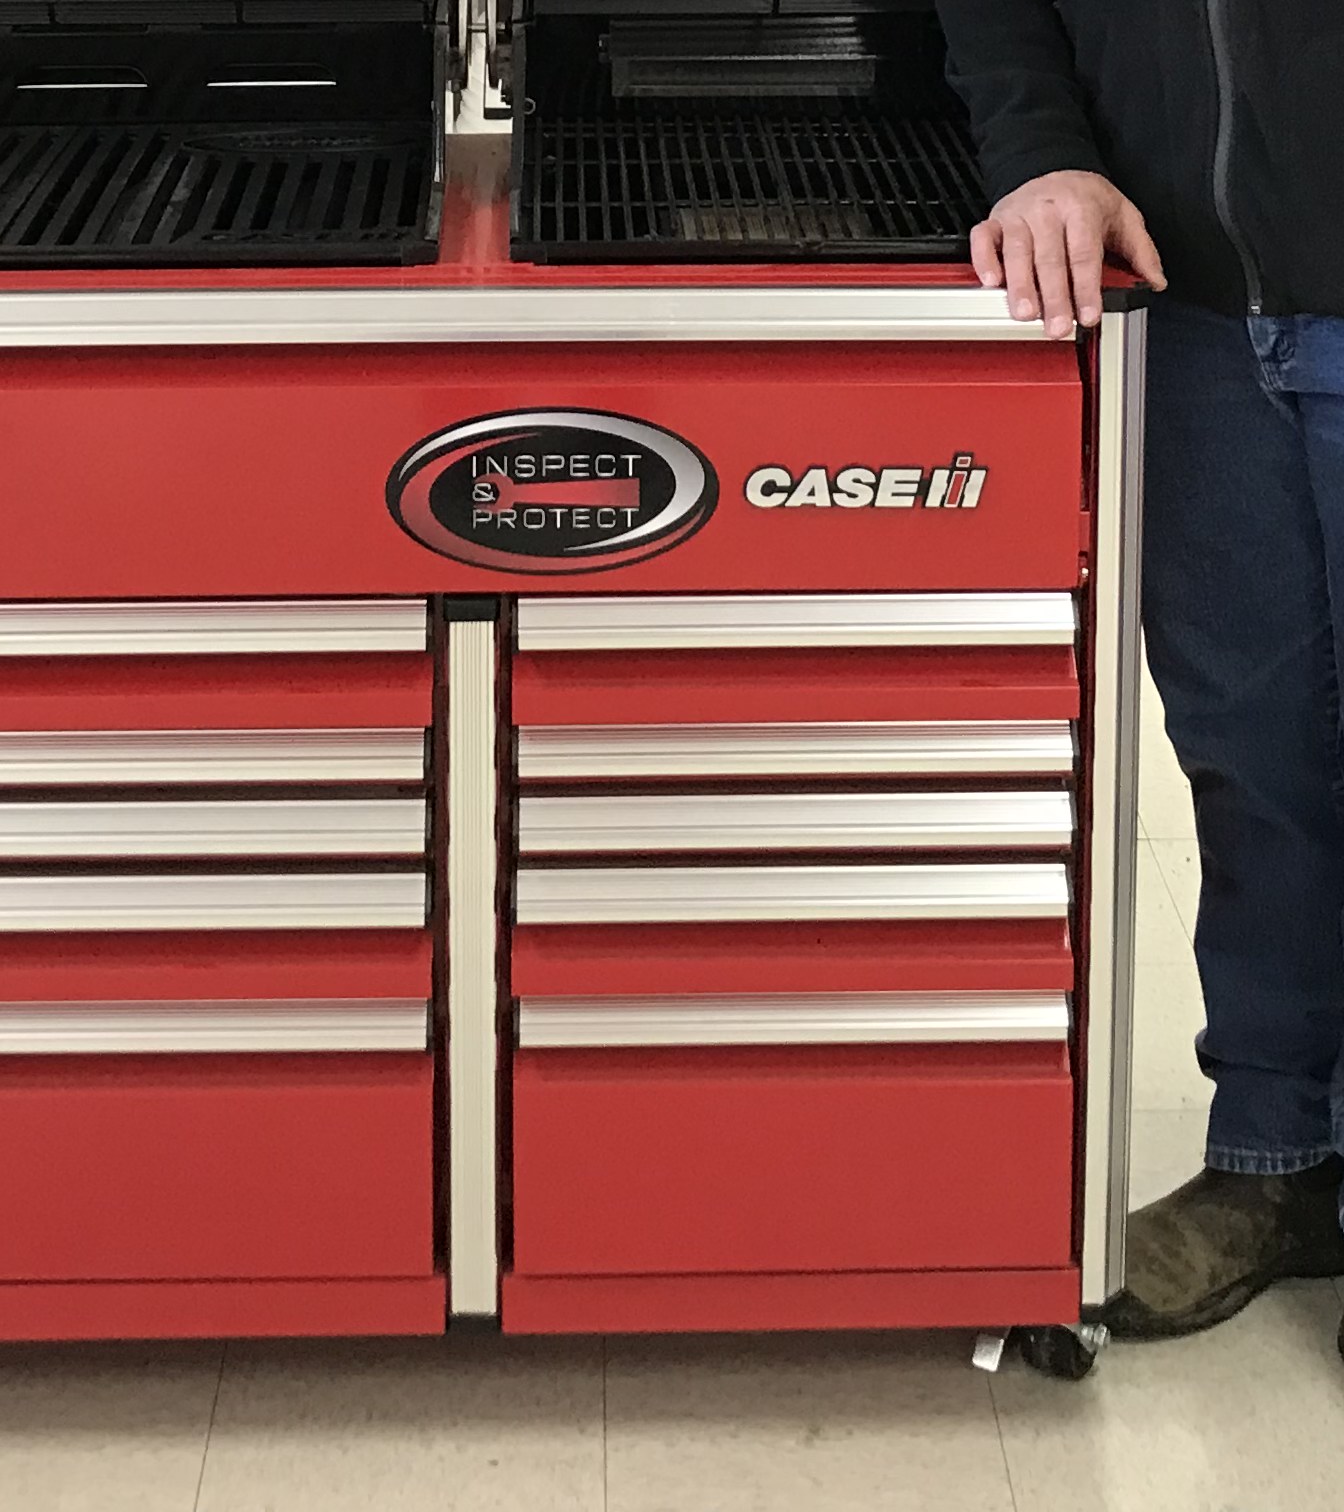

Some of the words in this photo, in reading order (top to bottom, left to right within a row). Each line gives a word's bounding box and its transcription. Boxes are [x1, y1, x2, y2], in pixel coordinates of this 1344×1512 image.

[471, 454, 642, 478] INSPECT
[472, 482, 495, 502] &
[746, 467, 923, 508] CASE
[472, 508, 640, 529] PROTECT
